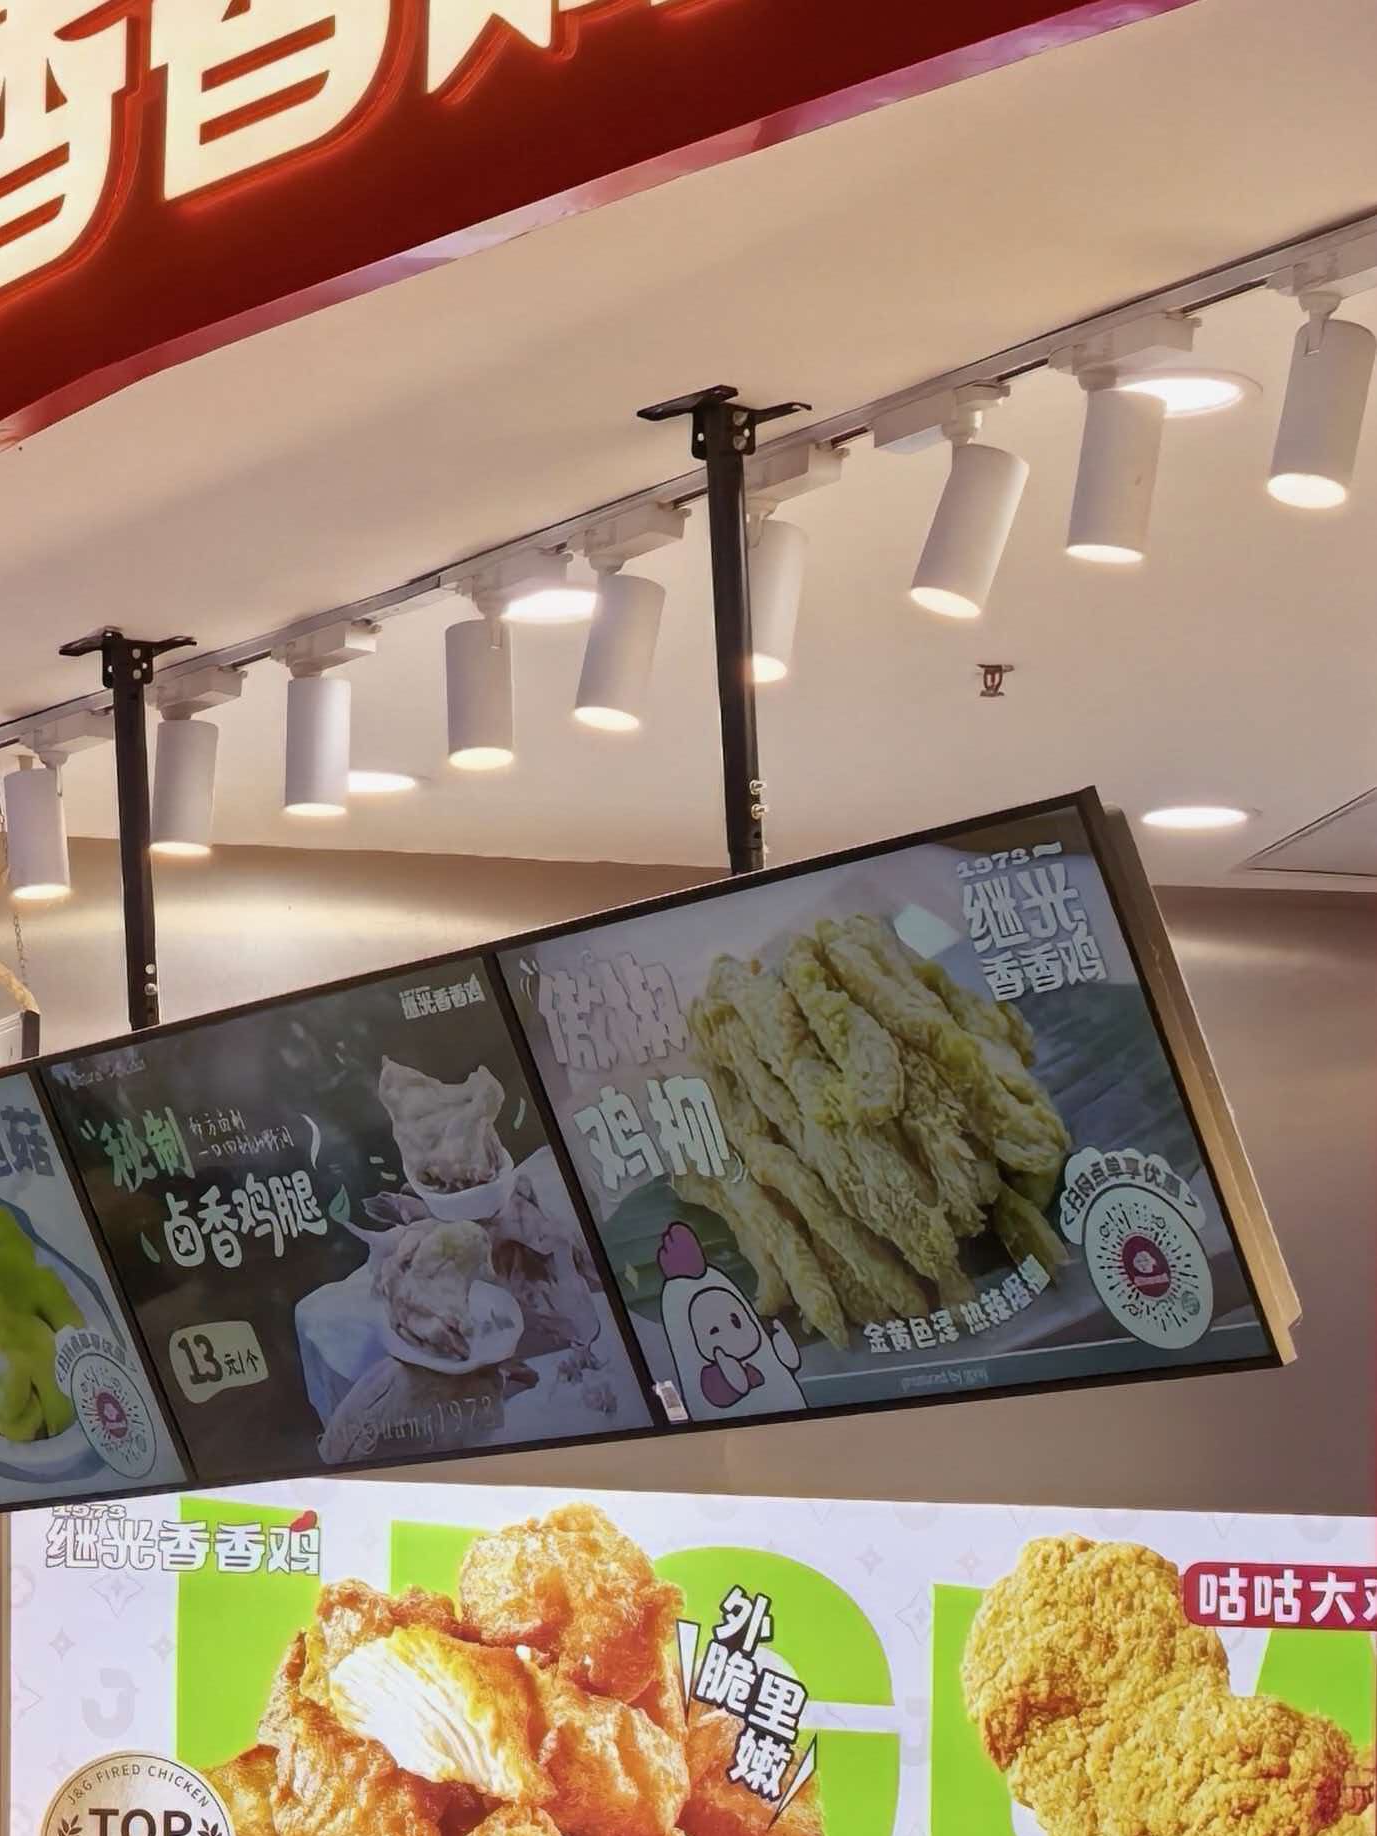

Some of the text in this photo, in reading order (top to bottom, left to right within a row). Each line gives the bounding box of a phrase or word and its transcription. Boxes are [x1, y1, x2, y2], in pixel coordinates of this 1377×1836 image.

[963, 863, 1088, 953] 继光
[980, 922, 1107, 1002] 香香鸡
[573, 1074, 730, 1191] 鸡柳
[163, 1169, 328, 1269] 卤香鸡腿
[45, 1517, 320, 1576] 继光香香鸡
[96, 1764, 141, 1783] FIRED
[147, 1765, 210, 1808] CHICKEN
